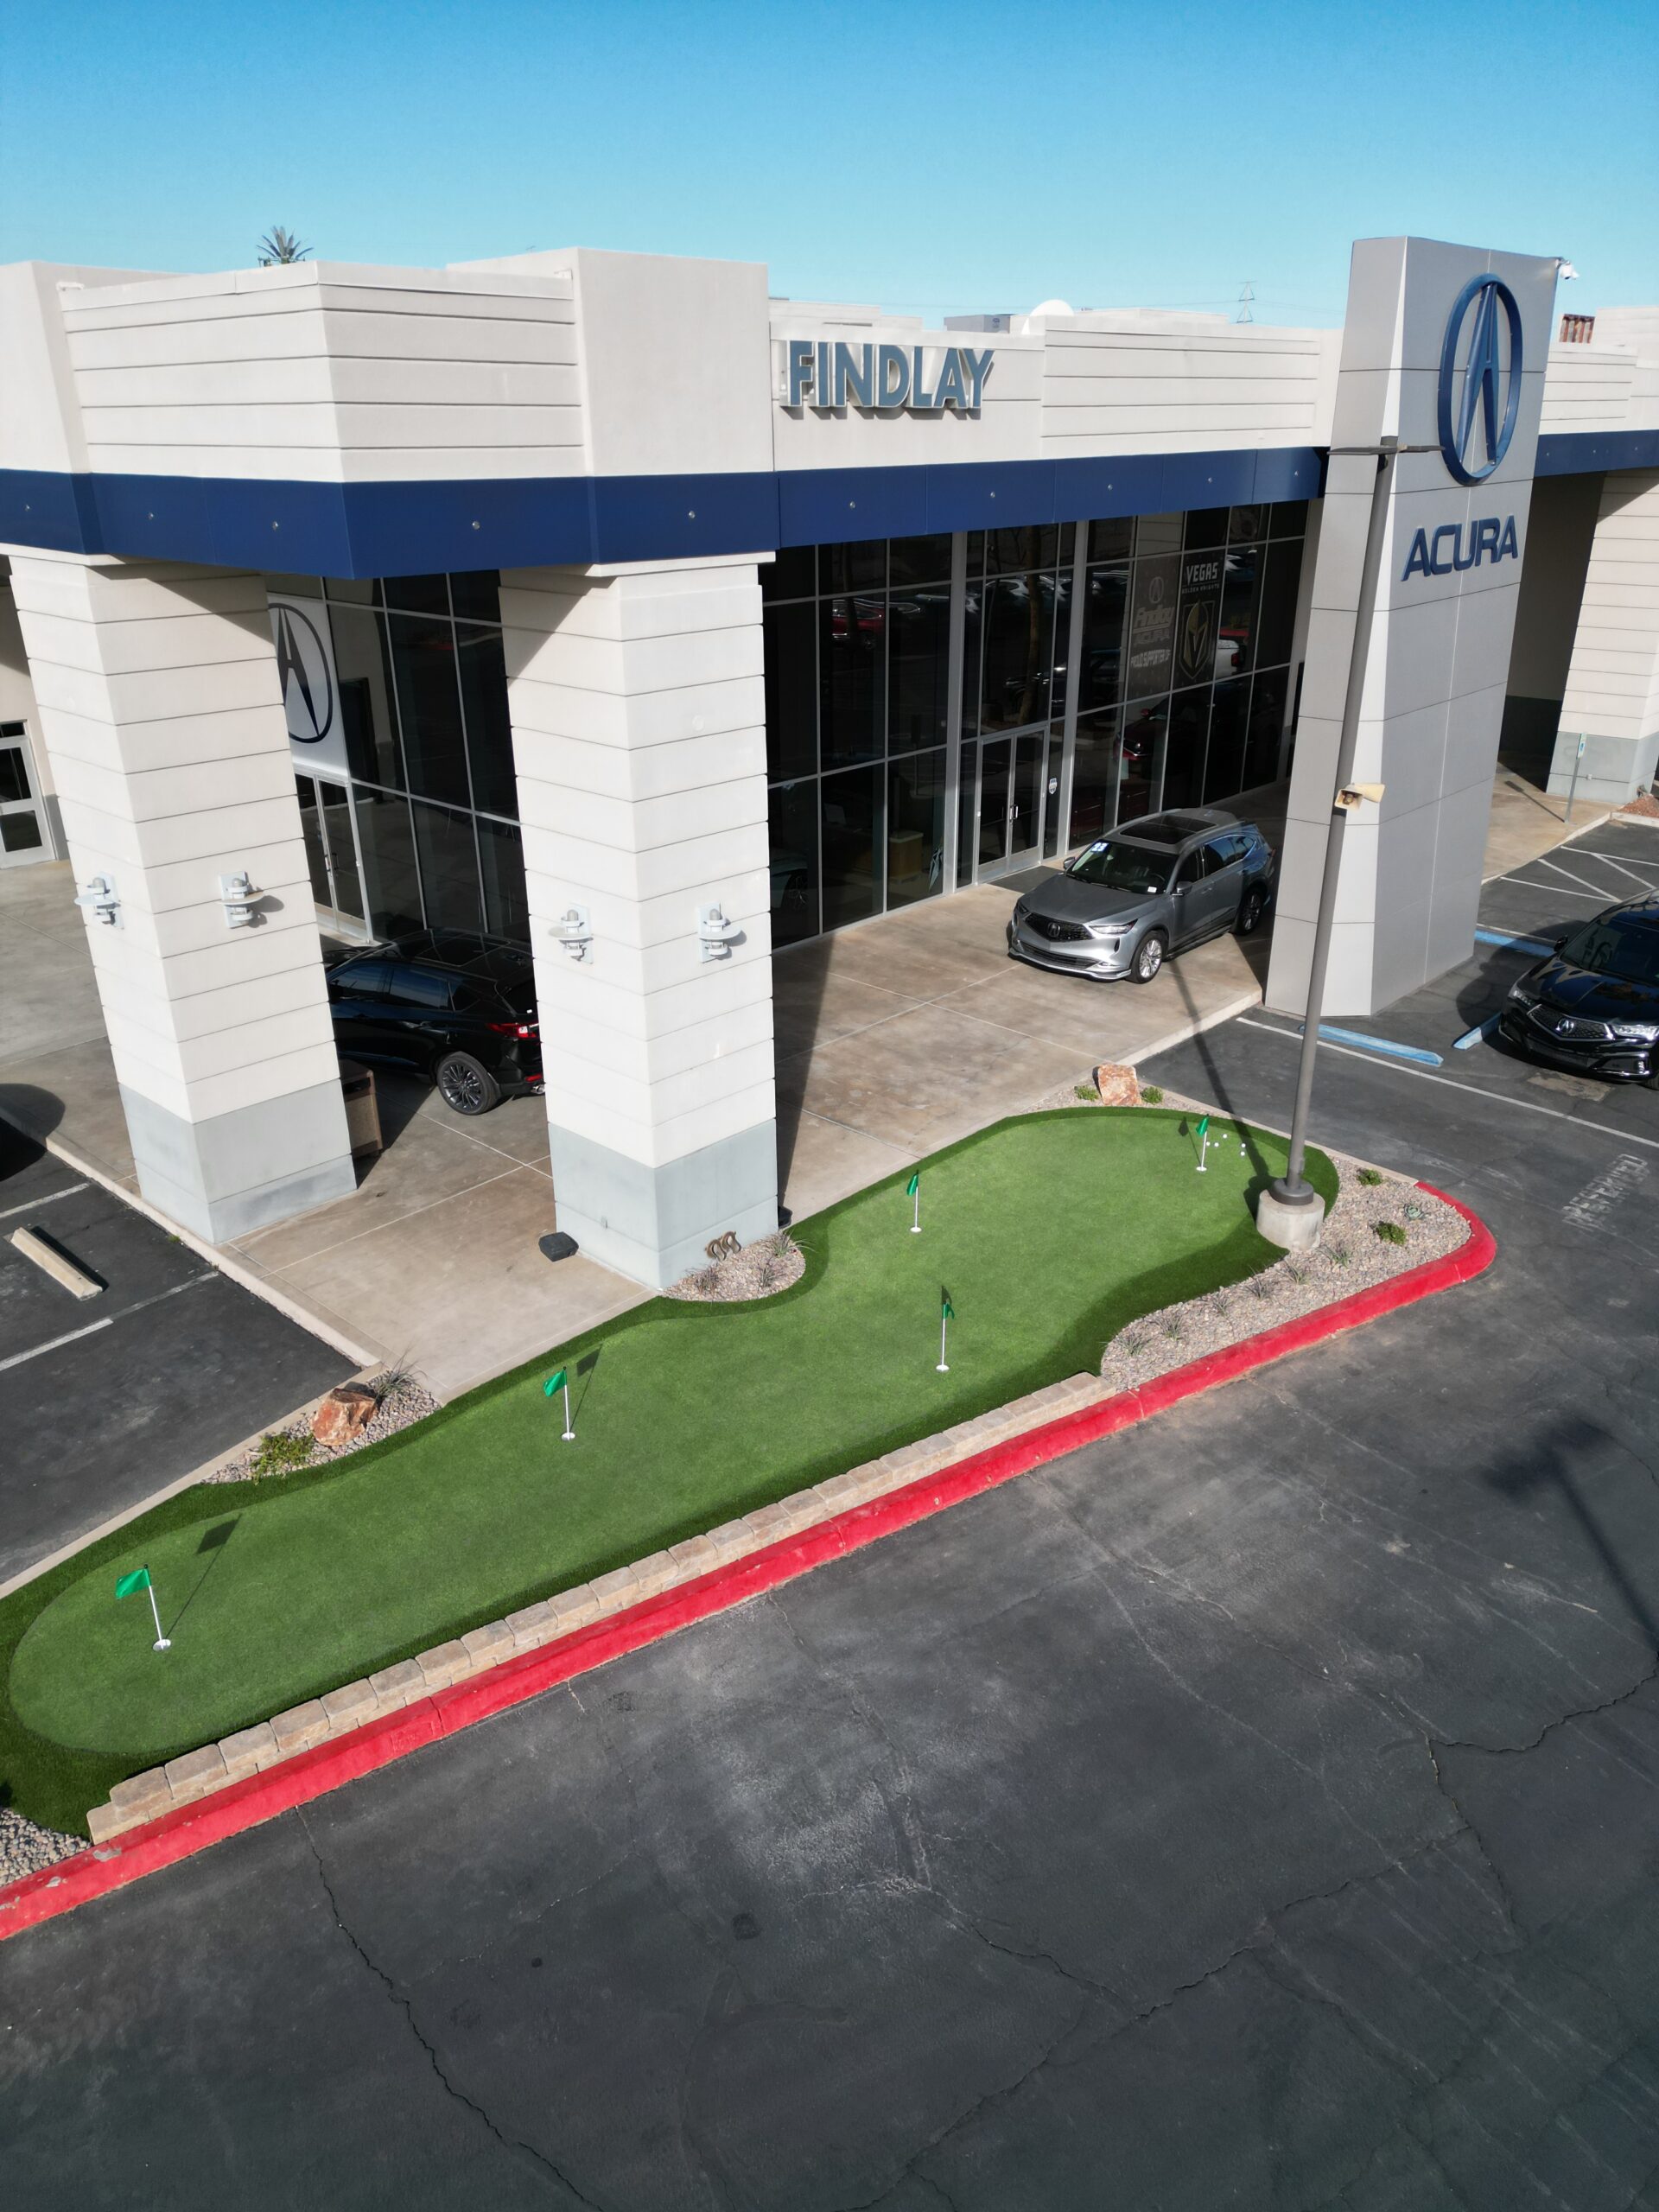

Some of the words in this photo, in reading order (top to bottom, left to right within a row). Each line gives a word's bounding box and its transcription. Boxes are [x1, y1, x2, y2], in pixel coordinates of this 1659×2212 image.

[784, 340, 995, 409] FINDLAY
[1401, 514, 1519, 582] ACURA
[1186, 562, 1219, 586] VEGAS
[1091, 842, 1109, 852] 23
